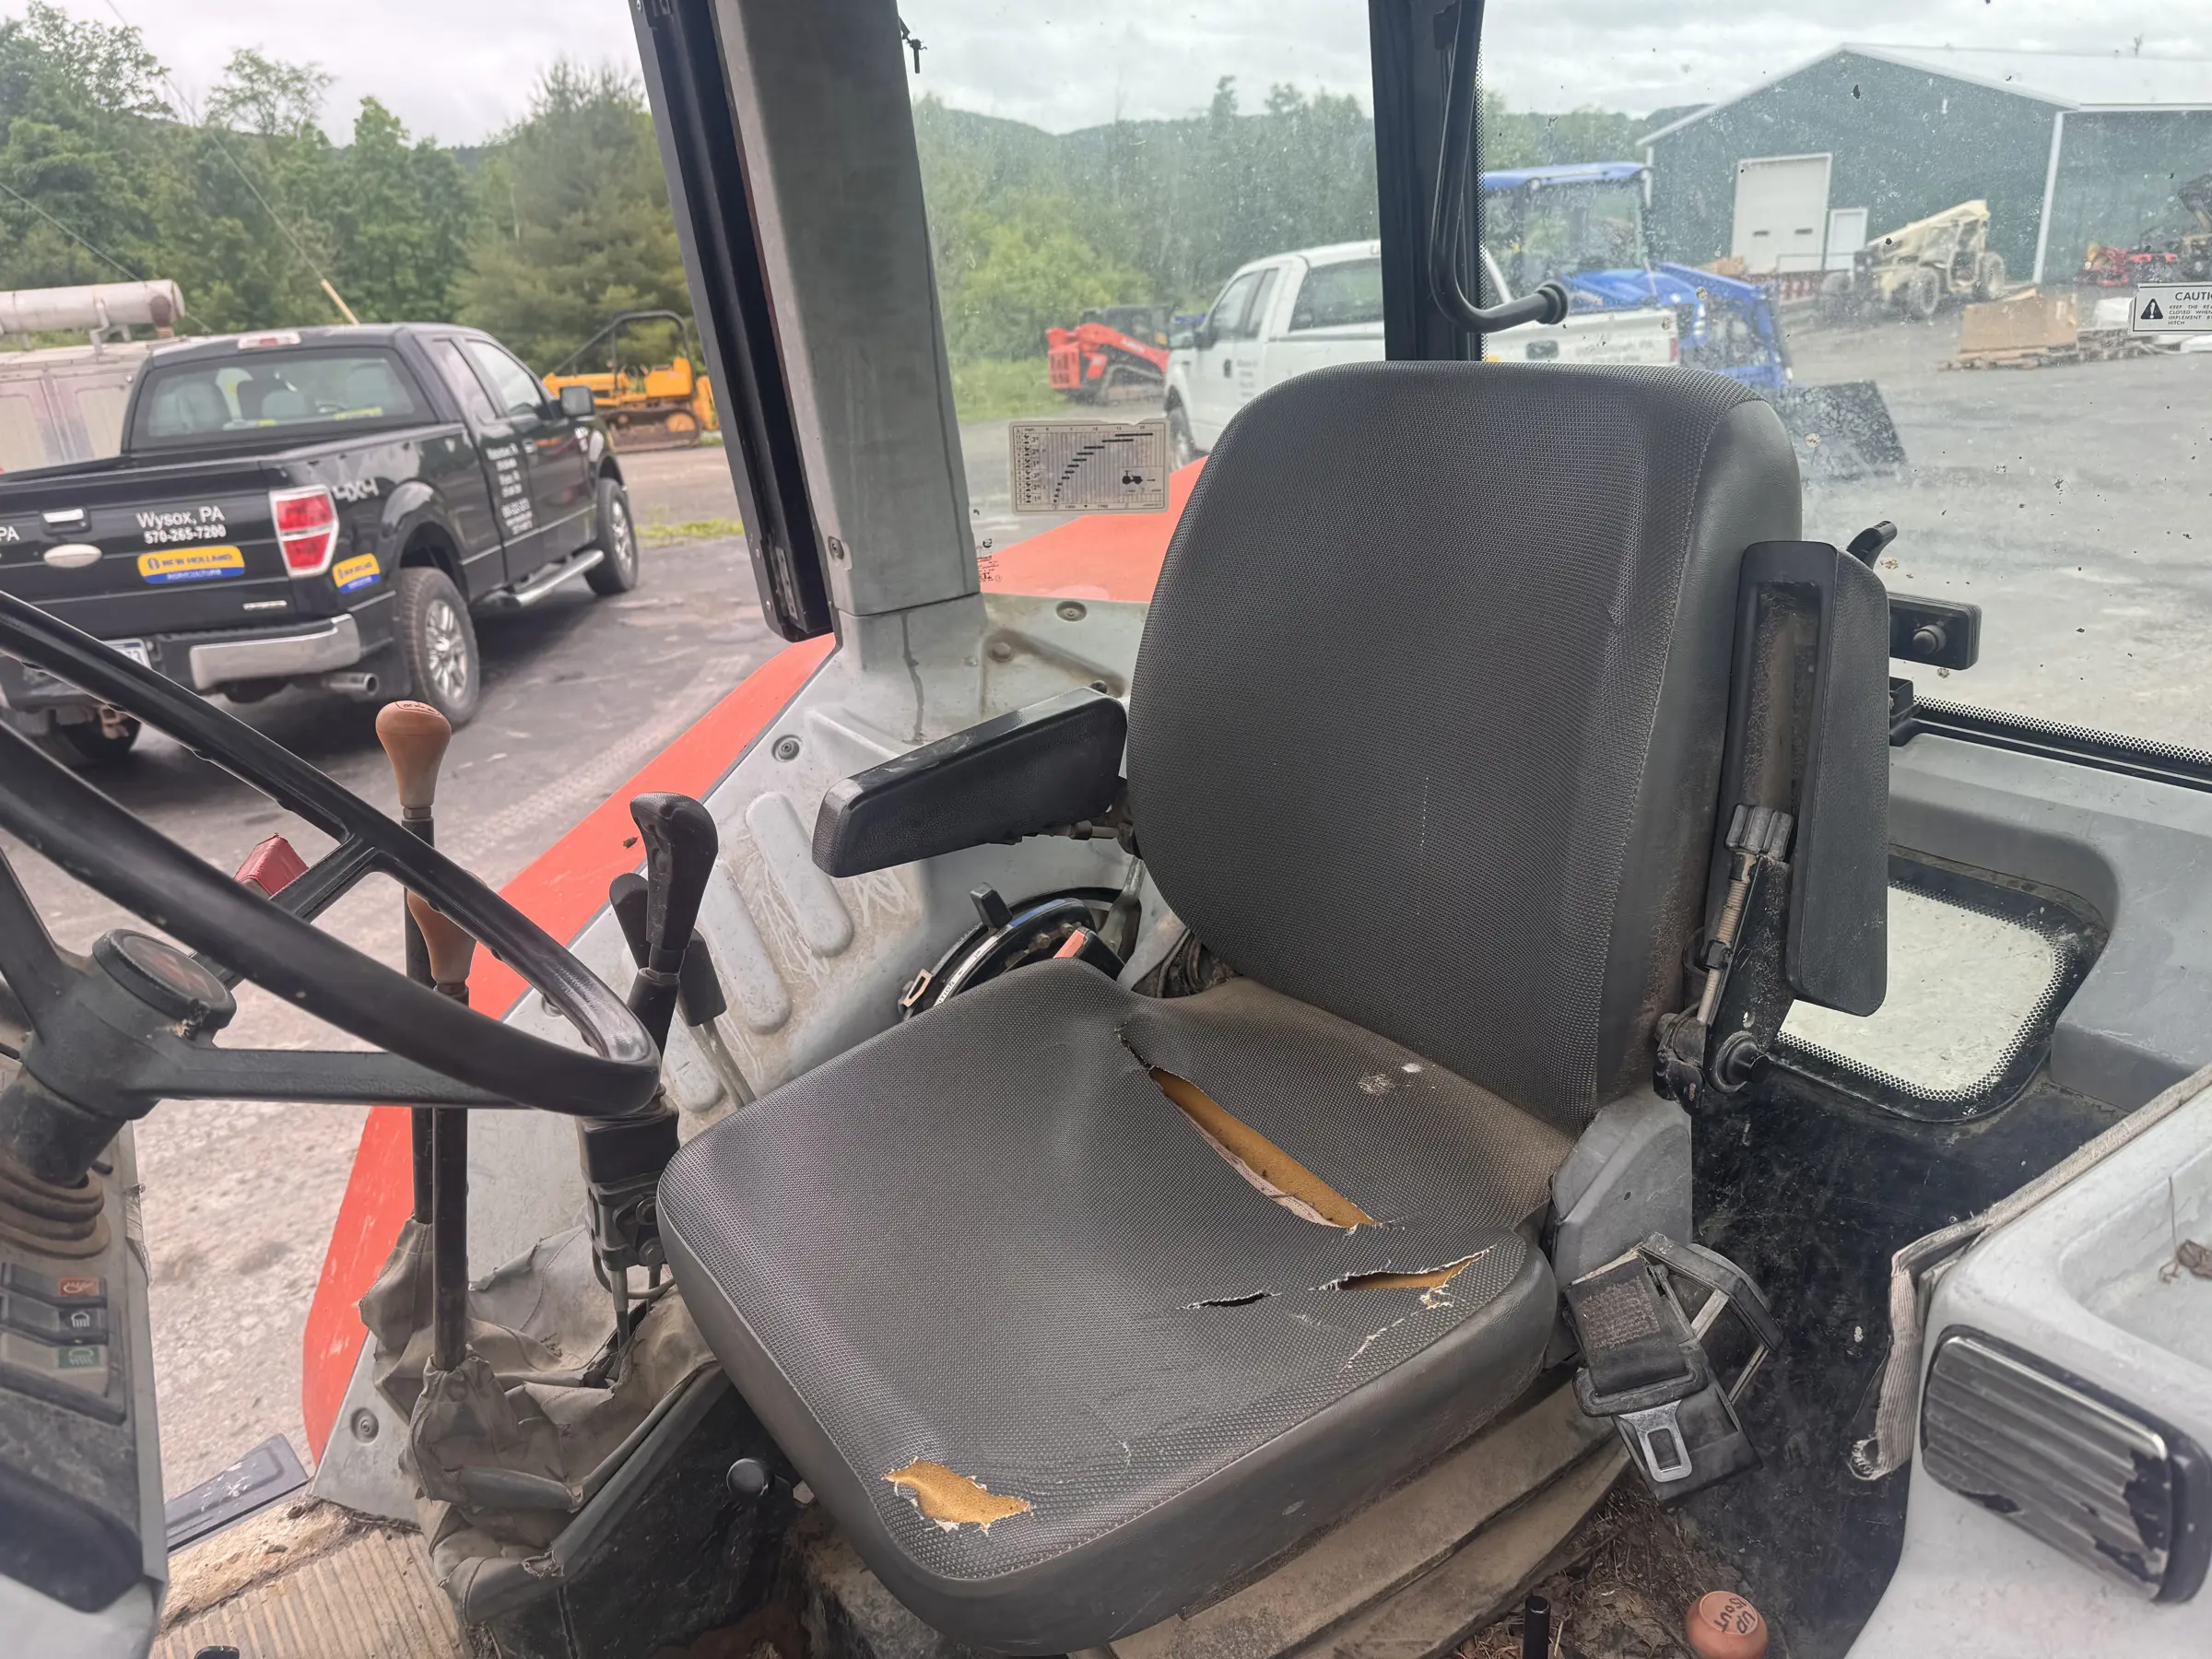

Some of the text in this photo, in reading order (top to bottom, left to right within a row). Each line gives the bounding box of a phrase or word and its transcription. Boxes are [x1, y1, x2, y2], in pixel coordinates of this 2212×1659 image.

[135, 505, 226, 530] Wysox, PA
[0, 525, 19, 542] PA
[1736, 1610, 1756, 1634] UP
